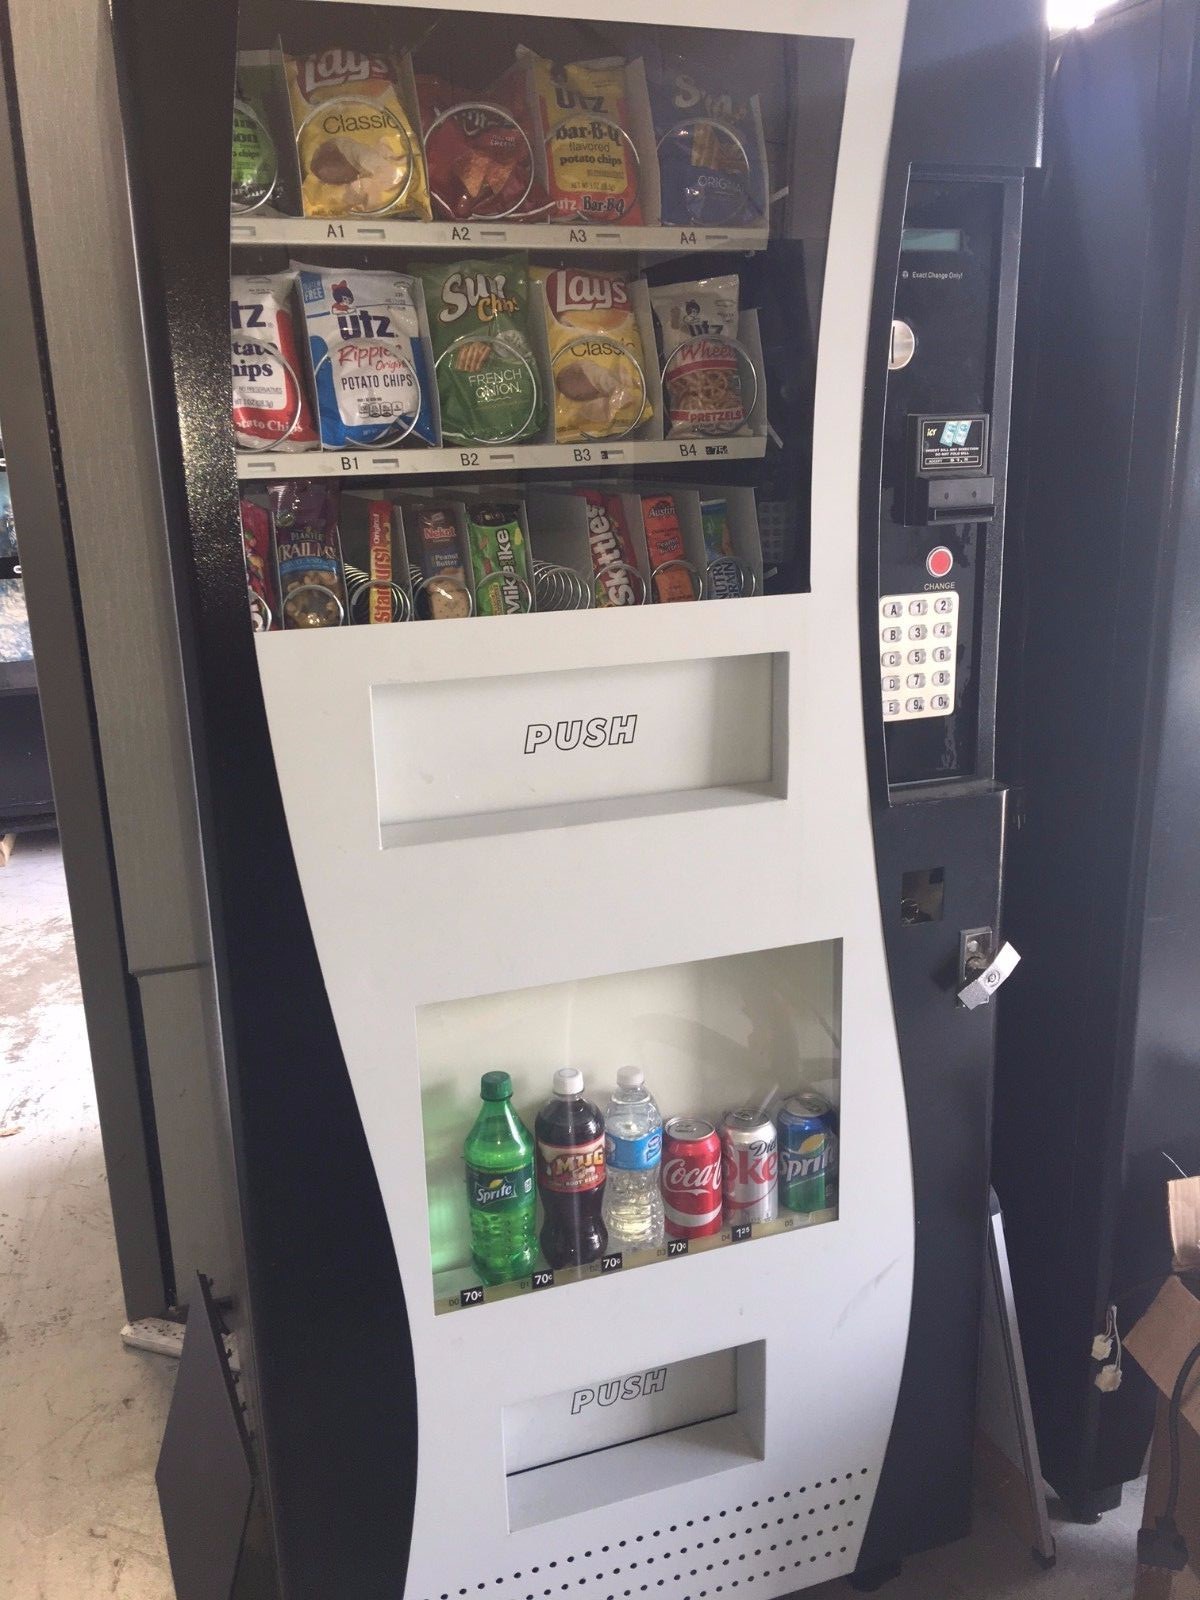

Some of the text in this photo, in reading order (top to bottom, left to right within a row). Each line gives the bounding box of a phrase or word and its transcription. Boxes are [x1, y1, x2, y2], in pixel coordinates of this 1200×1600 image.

[323, 113, 399, 135] Classic
[569, 141, 610, 153] flavored
[560, 154, 623, 167] potato chips
[327, 223, 344, 238] A1
[451, 226, 471, 241] A2
[569, 229, 587, 243] A3
[680, 231, 697, 245] A4
[912, 271, 963, 280] Exact Change Only!
[304, 287, 323, 298] FREE
[439, 273, 507, 323] Sun
[231, 301, 267, 329] tz
[232, 342, 279, 356] tato
[681, 340, 735, 360] Whee
[231, 359, 273, 381] ips
[376, 359, 411, 373] Origin
[341, 373, 414, 391] POTATO CHIPS
[468, 368, 523, 387] FRENCH
[475, 381, 522, 399] ONION
[690, 409, 744, 421] PRETZELS
[267, 419, 303, 433] Chis
[574, 449, 592, 462] B3
[679, 444, 697, 457] B4
[341, 457, 359, 471] B1
[460, 453, 480, 466] B2
[648, 505, 676, 518] Austin
[373, 513, 381, 544] Original
[424, 526, 456, 539] Nekot
[496, 529, 513, 560] Ike
[374, 546, 391, 624] Starurst
[713, 563, 726, 599] NUTR
[723, 562, 738, 599] RAIN
[923, 581, 956, 591] CHANGE
[503, 566, 520, 614] Mike
[890, 600, 946, 616] A 1 2
[890, 624, 946, 641] B 3 4
[889, 649, 945, 665] C 5 6
[889, 672, 945, 689] D 7 8
[888, 696, 944, 712] E 9 0
[524, 714, 637, 754] PUSH
[555, 1148, 604, 1175] MUG
[727, 1150, 777, 1187] oke
[476, 1183, 513, 1204] Sprite
[571, 1368, 667, 1415] PUSH
